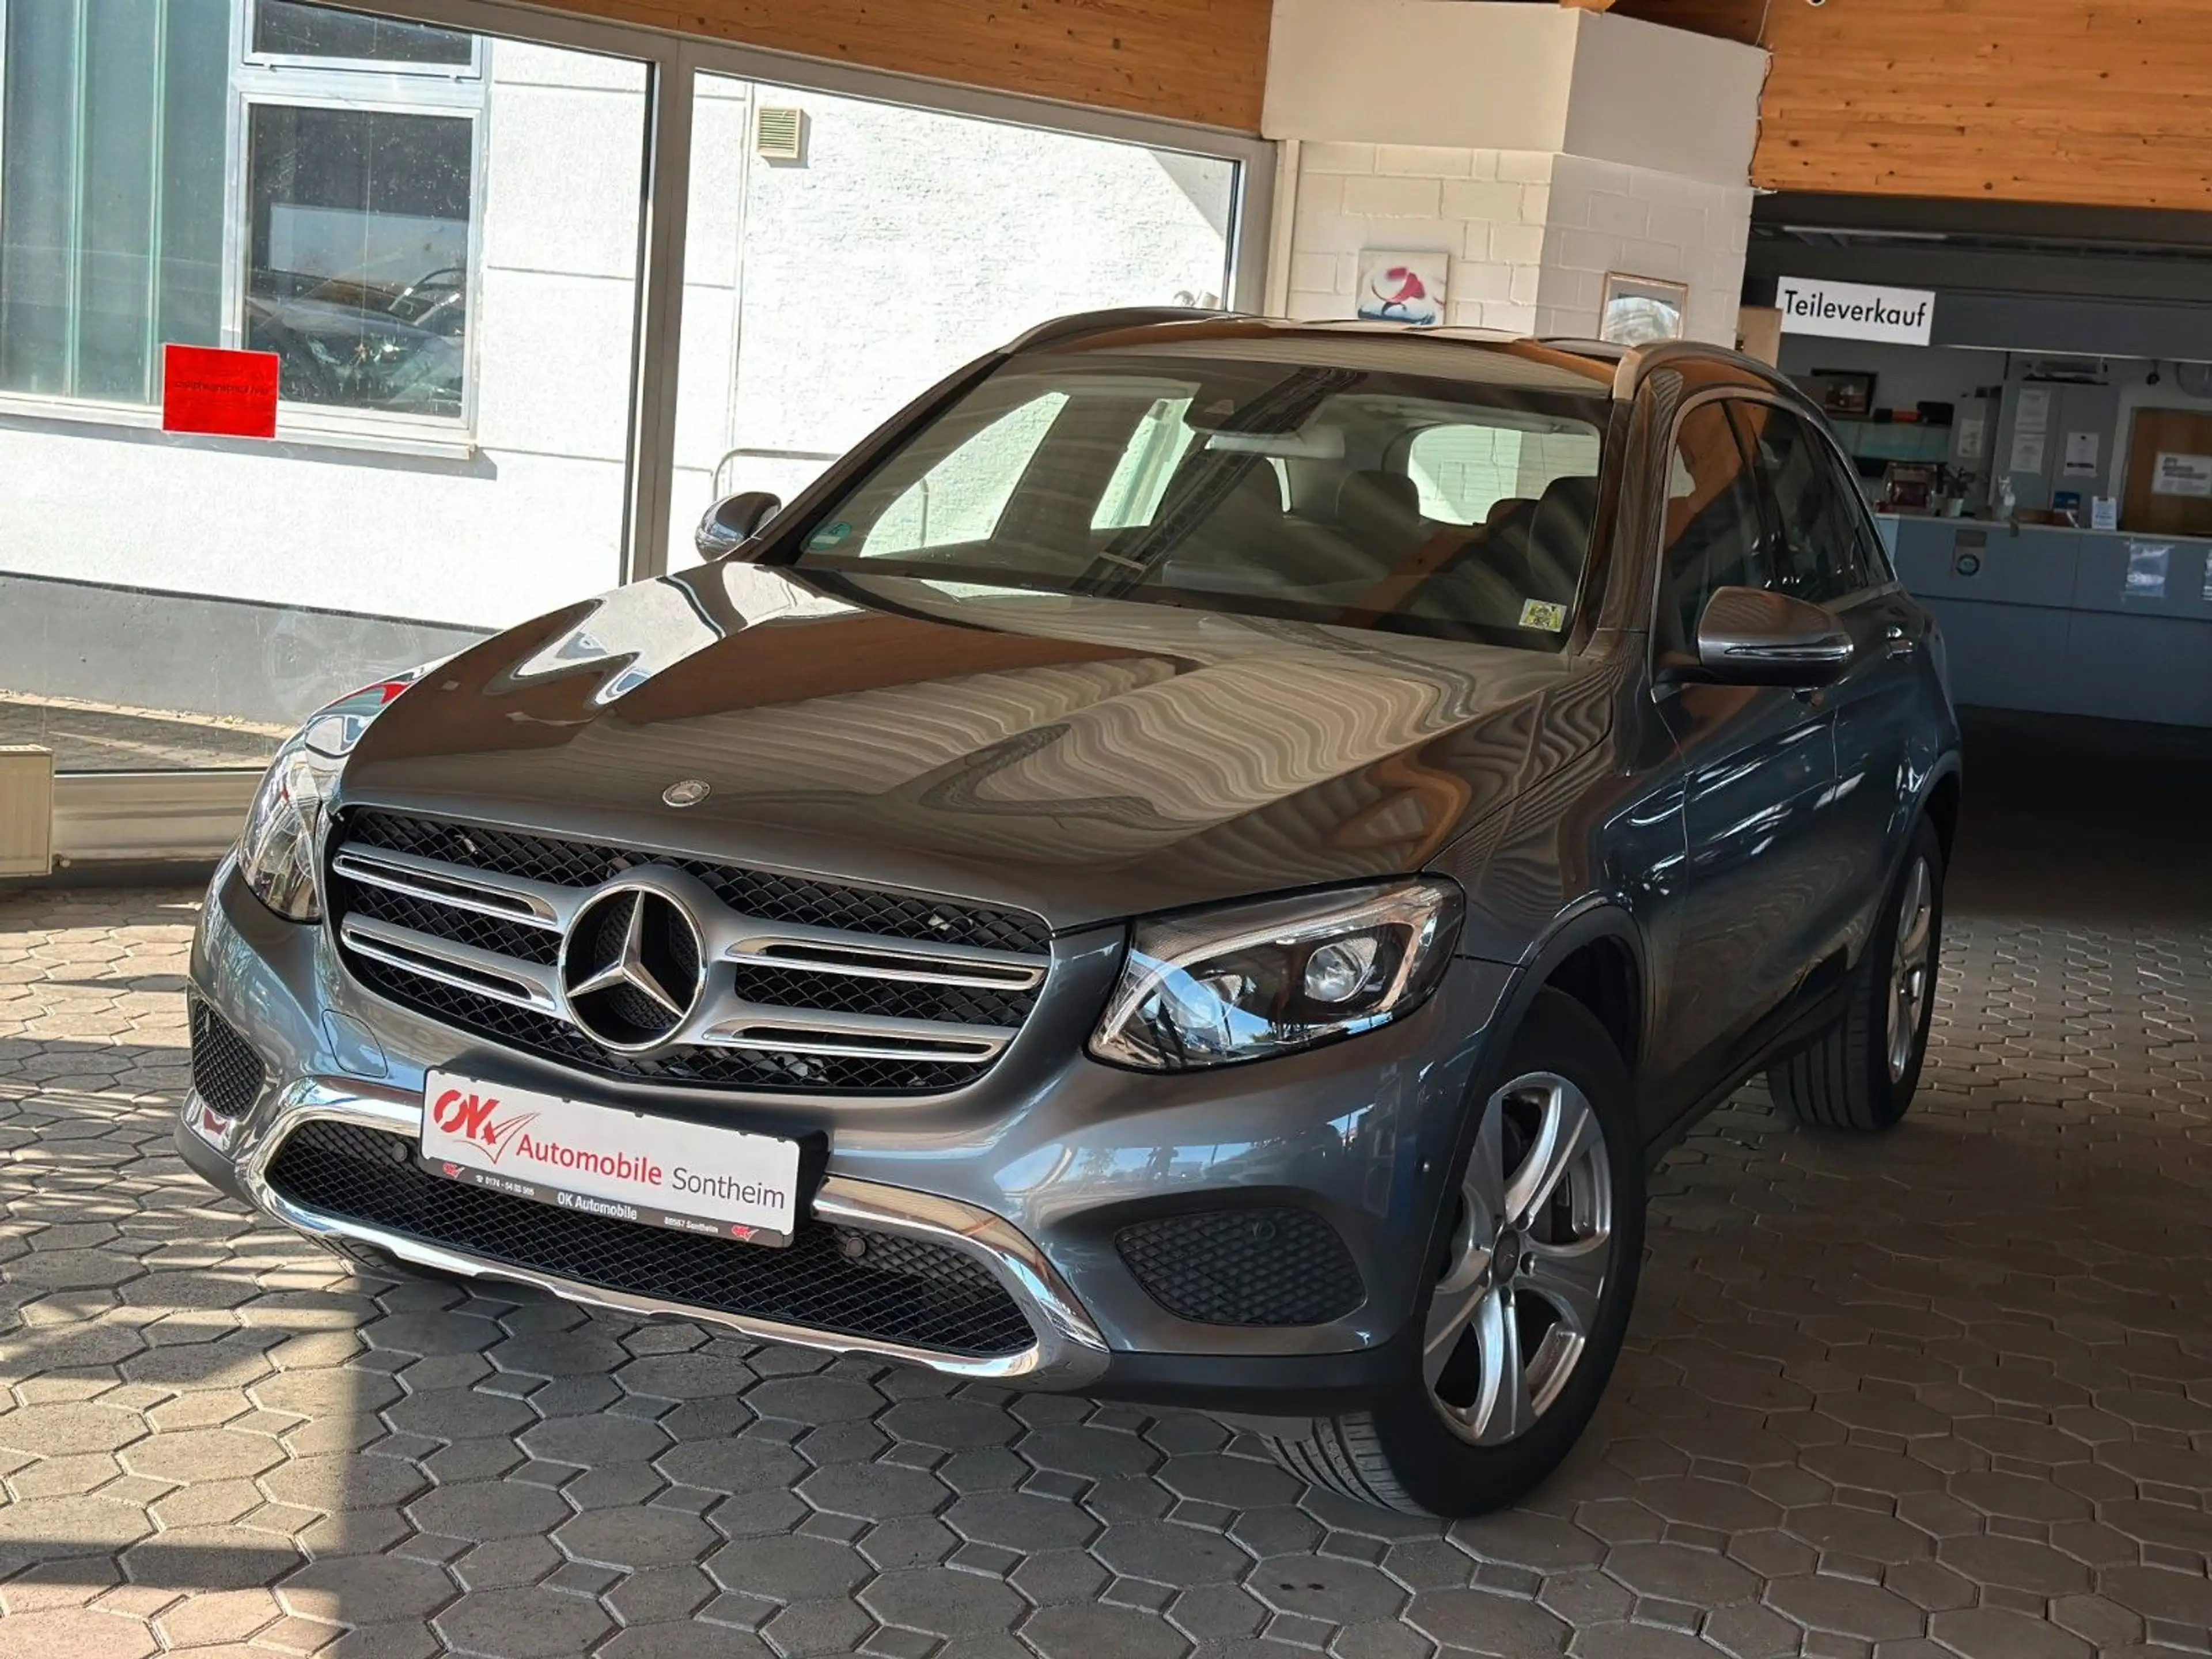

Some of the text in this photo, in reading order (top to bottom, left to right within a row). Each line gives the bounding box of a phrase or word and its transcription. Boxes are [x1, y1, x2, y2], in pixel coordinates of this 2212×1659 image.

[1785, 290, 1927, 327] Teileverkauf
[434, 1089, 500, 1145] OK
[516, 1134, 785, 1209] Automobile Sontheim
[557, 1192, 637, 1221] OK Automobile
